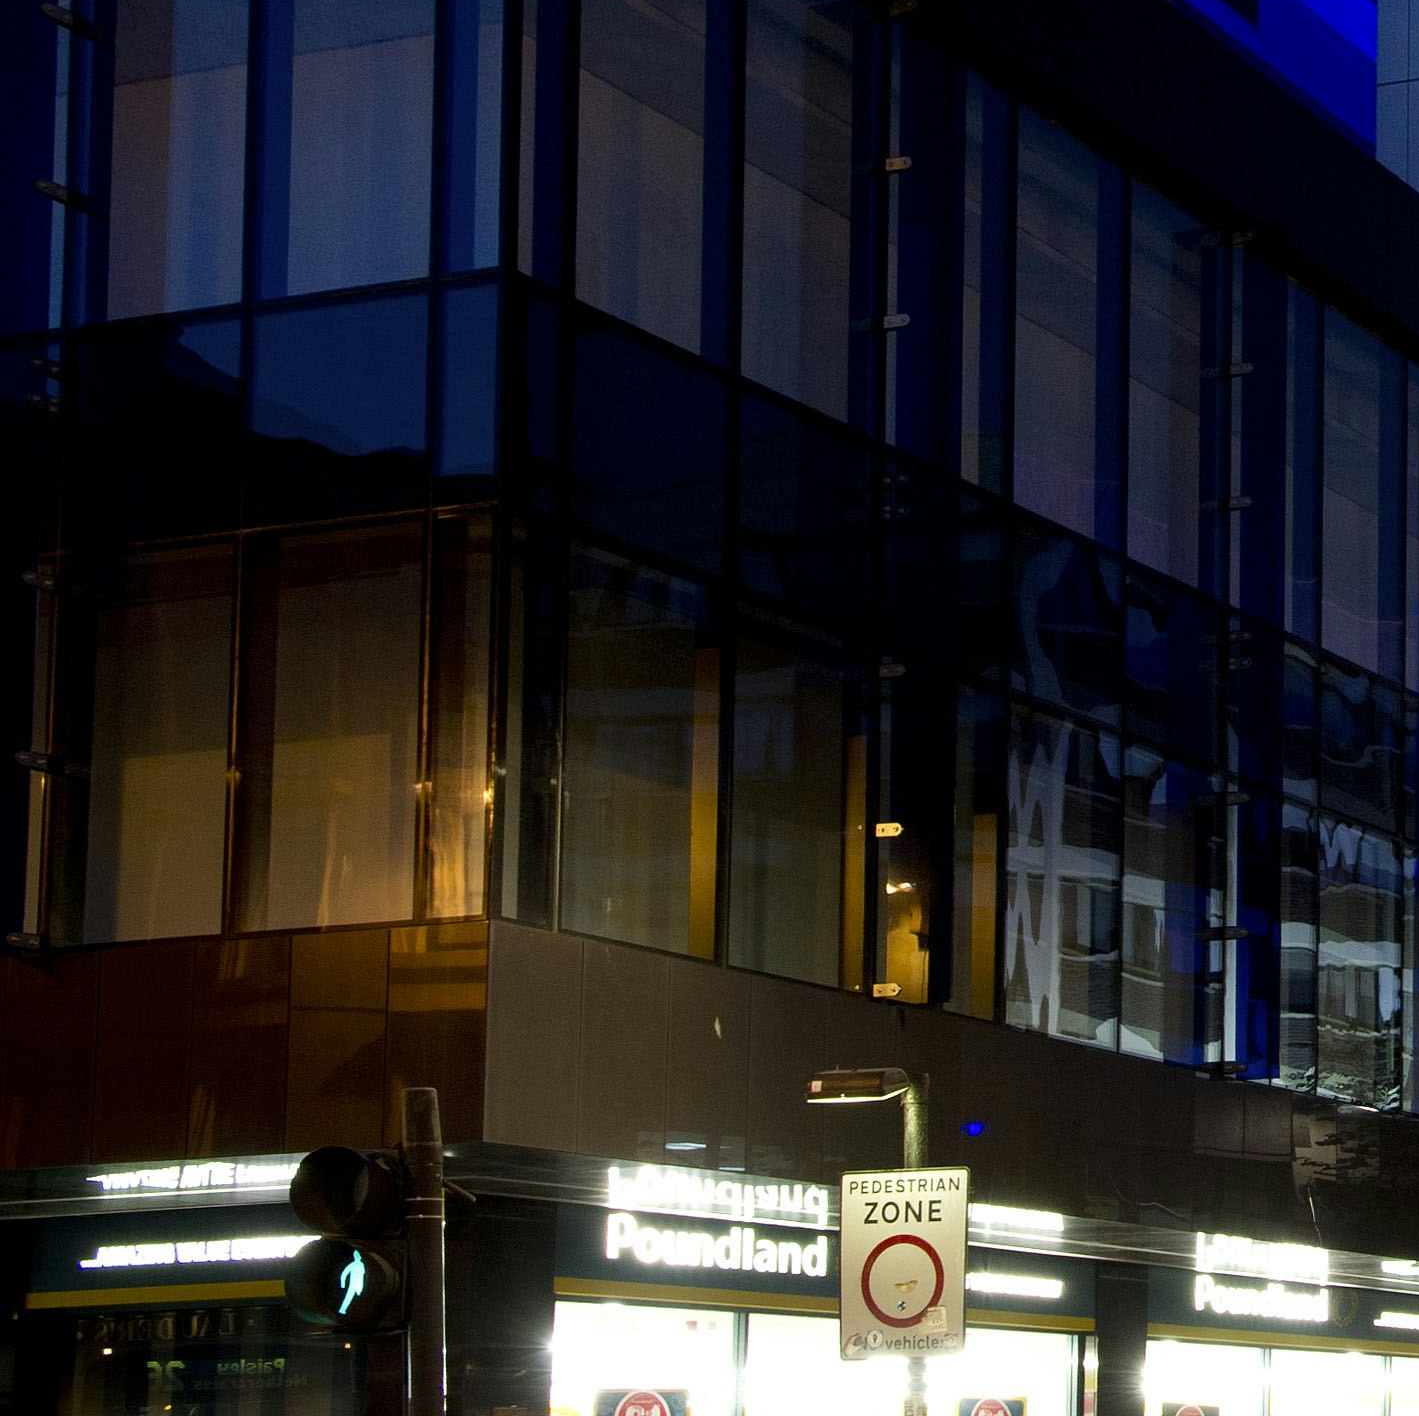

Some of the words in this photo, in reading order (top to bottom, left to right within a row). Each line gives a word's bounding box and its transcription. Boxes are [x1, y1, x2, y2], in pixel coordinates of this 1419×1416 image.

[849, 1177, 960, 1195] PEDESTRIAN
[863, 1200, 942, 1224] ZONE
[606, 1212, 828, 1276] Poundland
[884, 1335, 945, 1351] vehicle
